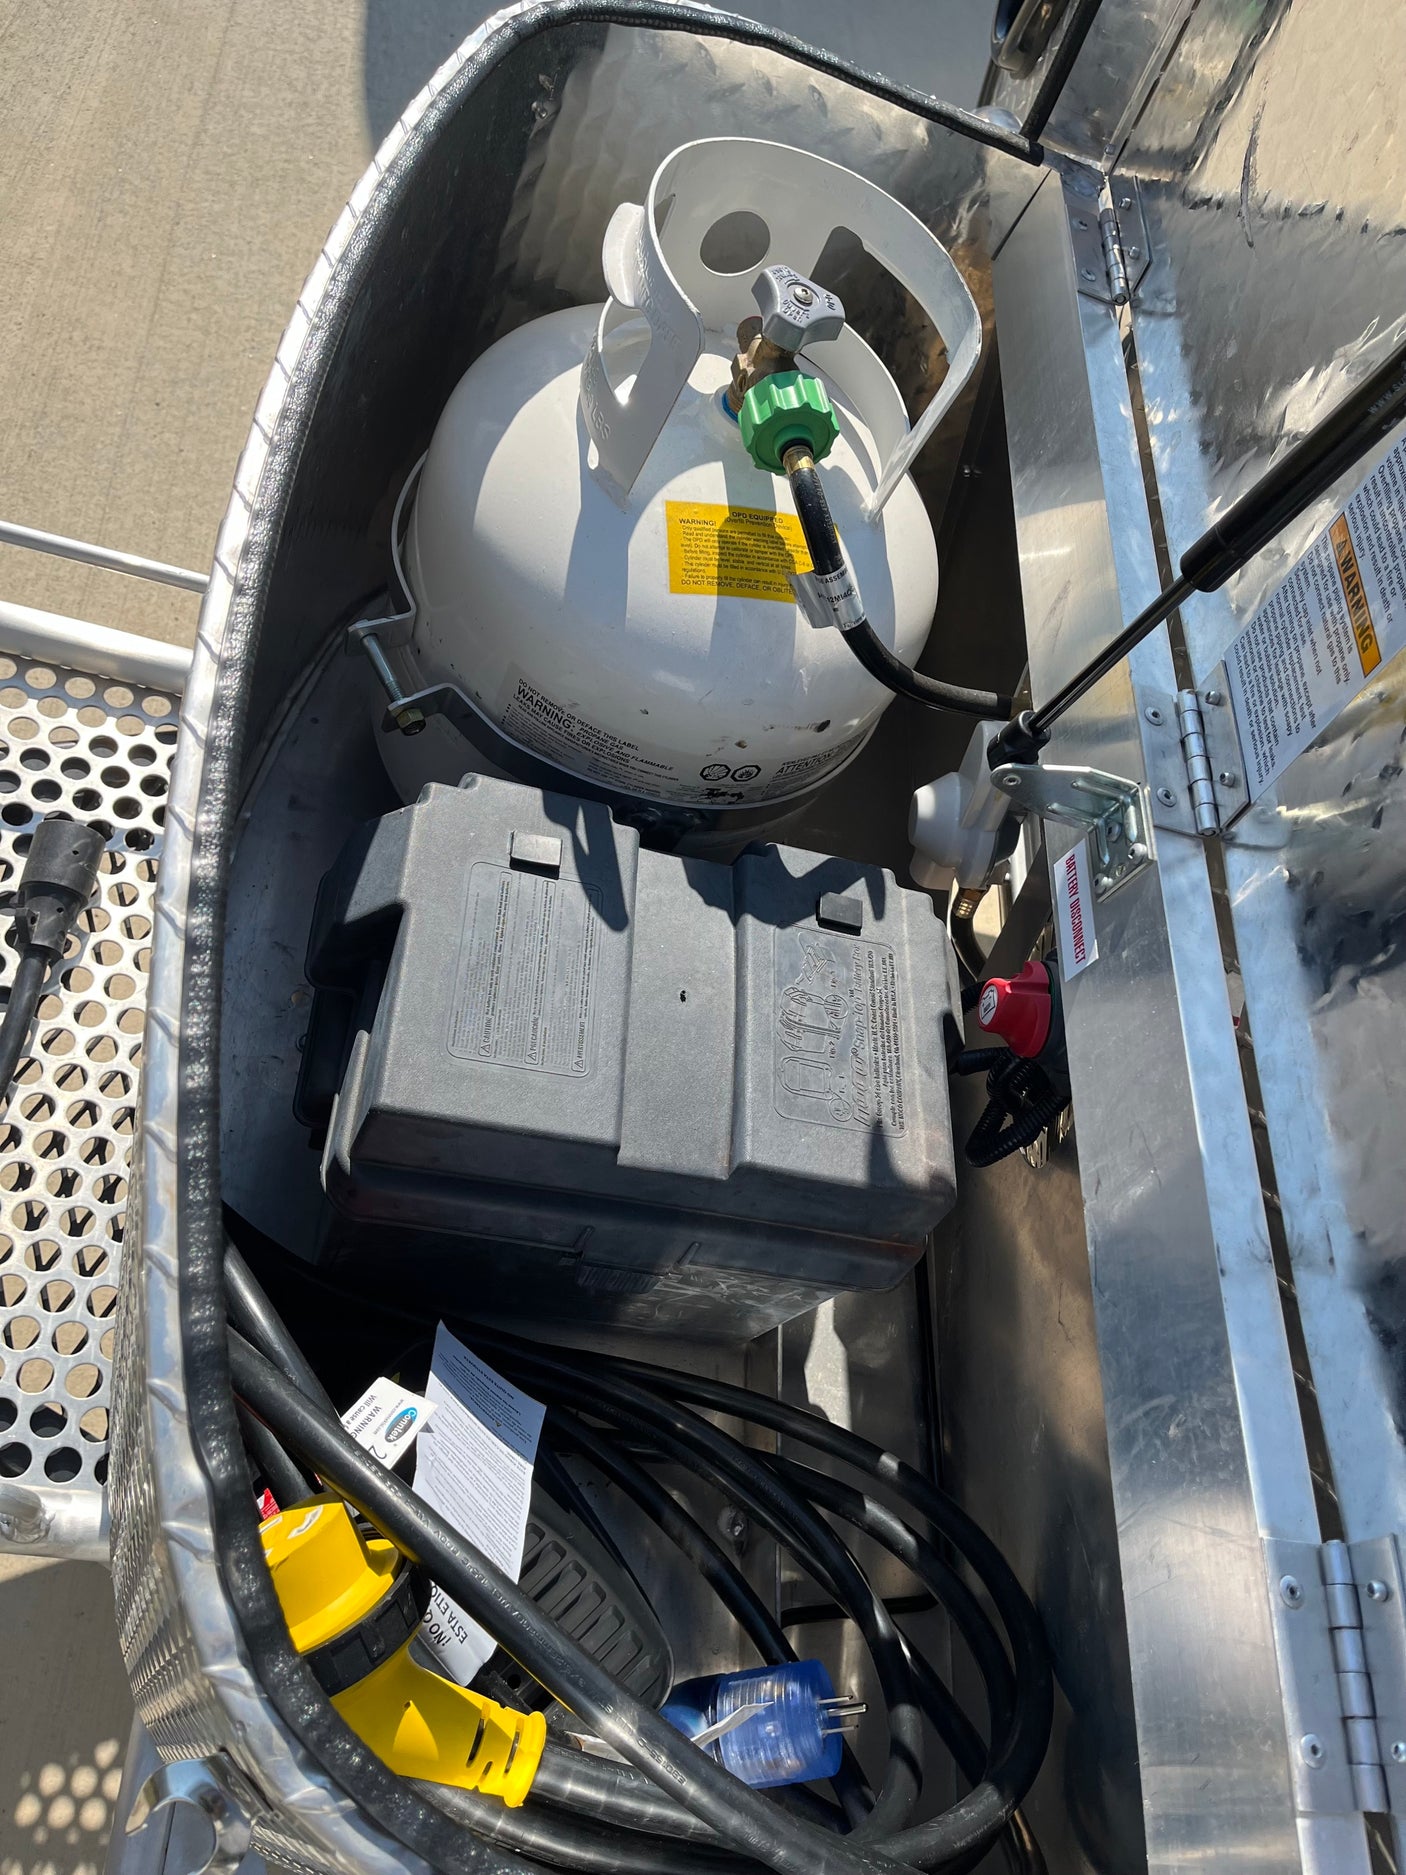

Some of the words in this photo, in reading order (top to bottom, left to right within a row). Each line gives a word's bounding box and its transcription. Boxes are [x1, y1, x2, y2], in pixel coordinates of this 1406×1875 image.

[1362, 482, 1373, 510] which
[1370, 473, 1381, 500] result
[1347, 501, 1359, 534] serious
[1354, 490, 1370, 536] explosion
[1376, 498, 1383, 509] in
[1377, 462, 1394, 511] Overfilling
[1388, 507, 1403, 549] propane
[679, 518, 716, 526] WARNING!
[1369, 507, 1380, 535] could
[1366, 532, 1374, 551] and
[1375, 531, 1385, 554] lead
[1379, 505, 1398, 566] uncontrolled
[1307, 551, 1314, 565] Do
[1313, 542, 1326, 582] designed
[1370, 548, 1381, 577] result
[1380, 551, 1388, 564] to
[1383, 563, 1389, 571] a
[1322, 579, 1330, 593] for
[1376, 575, 1384, 587] in
[1385, 570, 1394, 587] fire
[1275, 591, 1285, 619] normal
[1281, 583, 1289, 604] After
[1287, 576, 1300, 618] connected
[1313, 578, 1324, 612] connect
[1324, 553, 1336, 589] propane
[1332, 585, 1343, 615] piping
[1338, 613, 1350, 646] system
[1339, 548, 1373, 657] WARNING
[1379, 584, 1390, 613] death
[1390, 587, 1396, 599] or
[1250, 622, 1257, 634] Do
[1256, 615, 1264, 636] water
[1268, 600, 1279, 633] propane
[1284, 603, 1296, 634] turning
[1292, 568, 1306, 604] Securely
[1300, 602, 1309, 620] cap
[1309, 635, 1319, 660] when
[1314, 659, 1322, 675] not
[1320, 610, 1332, 641] natural
[1329, 608, 1338, 628] with
[1386, 612, 1393, 625] or
[1261, 637, 1266, 646] or
[1274, 631, 1285, 659] piping
[1279, 618, 1292, 653] cylinder
[1291, 633, 1298, 645] on
[1326, 640, 1335, 659] gas
[1332, 627, 1345, 665] propane
[1233, 644, 1241, 666] could
[1263, 645, 1273, 673] bubble
[1280, 656, 1288, 674] and
[1331, 656, 1338, 667] to
[1237, 665, 1246, 688] result
[1258, 663, 1270, 699] products
[1272, 660, 1285, 693] leakage
[1333, 666, 1342, 685] this
[1242, 687, 1248, 696] in
[1252, 665, 1257, 674] or
[1260, 706, 1266, 716] to
[1280, 691, 1288, 710] with
[1283, 672, 1299, 723] connections
[1301, 681, 1312, 711] except
[515, 684, 576, 732] WARNING:
[518, 677, 528, 687] DO
[527, 685, 540, 696] NOT
[566, 711, 577, 721] OR
[576, 718, 601, 735] DEFACE
[603, 731, 617, 742] THIS
[617, 736, 640, 753] LABEL
[1239, 636, 1247, 653] Can
[1245, 670, 1251, 679] to
[1251, 699, 1257, 709] or
[1261, 750, 1270, 776] which
[1243, 696, 1252, 720] death
[1266, 698, 1274, 715] that
[1298, 703, 1306, 720] test
[1308, 708, 1317, 729] after
[512, 693, 531, 709] LEAKS
[530, 707, 543, 718] MAY
[542, 716, 562, 731] CAUSE
[563, 729, 580, 741] FIRES
[580, 739, 590, 747] OR
[590, 743, 630, 764] EXPLOSIONS
[1248, 720, 1253, 728] or
[1269, 715, 1280, 747] contain
[1282, 711, 1293, 739] soapy
[1294, 722, 1301, 735] to
[576, 731, 614, 752] EXPLOSIVE
[615, 749, 630, 758] AND
[629, 754, 674, 771] FLAMMABLE
[578, 726, 608, 743] PROPANE
[609, 740, 623, 751] GAS
[1249, 730, 1260, 760] serious
[1066, 854, 1079, 898] BATTERY
[1070, 898, 1086, 964] DISCONNECT
[350, 1404, 366, 1421] cause
[364, 1394, 376, 1408] Will
[388, 1410, 416, 1440] Conntek
[429, 1622, 452, 1648] ¡NO
[446, 1611, 468, 1644] ESTA
